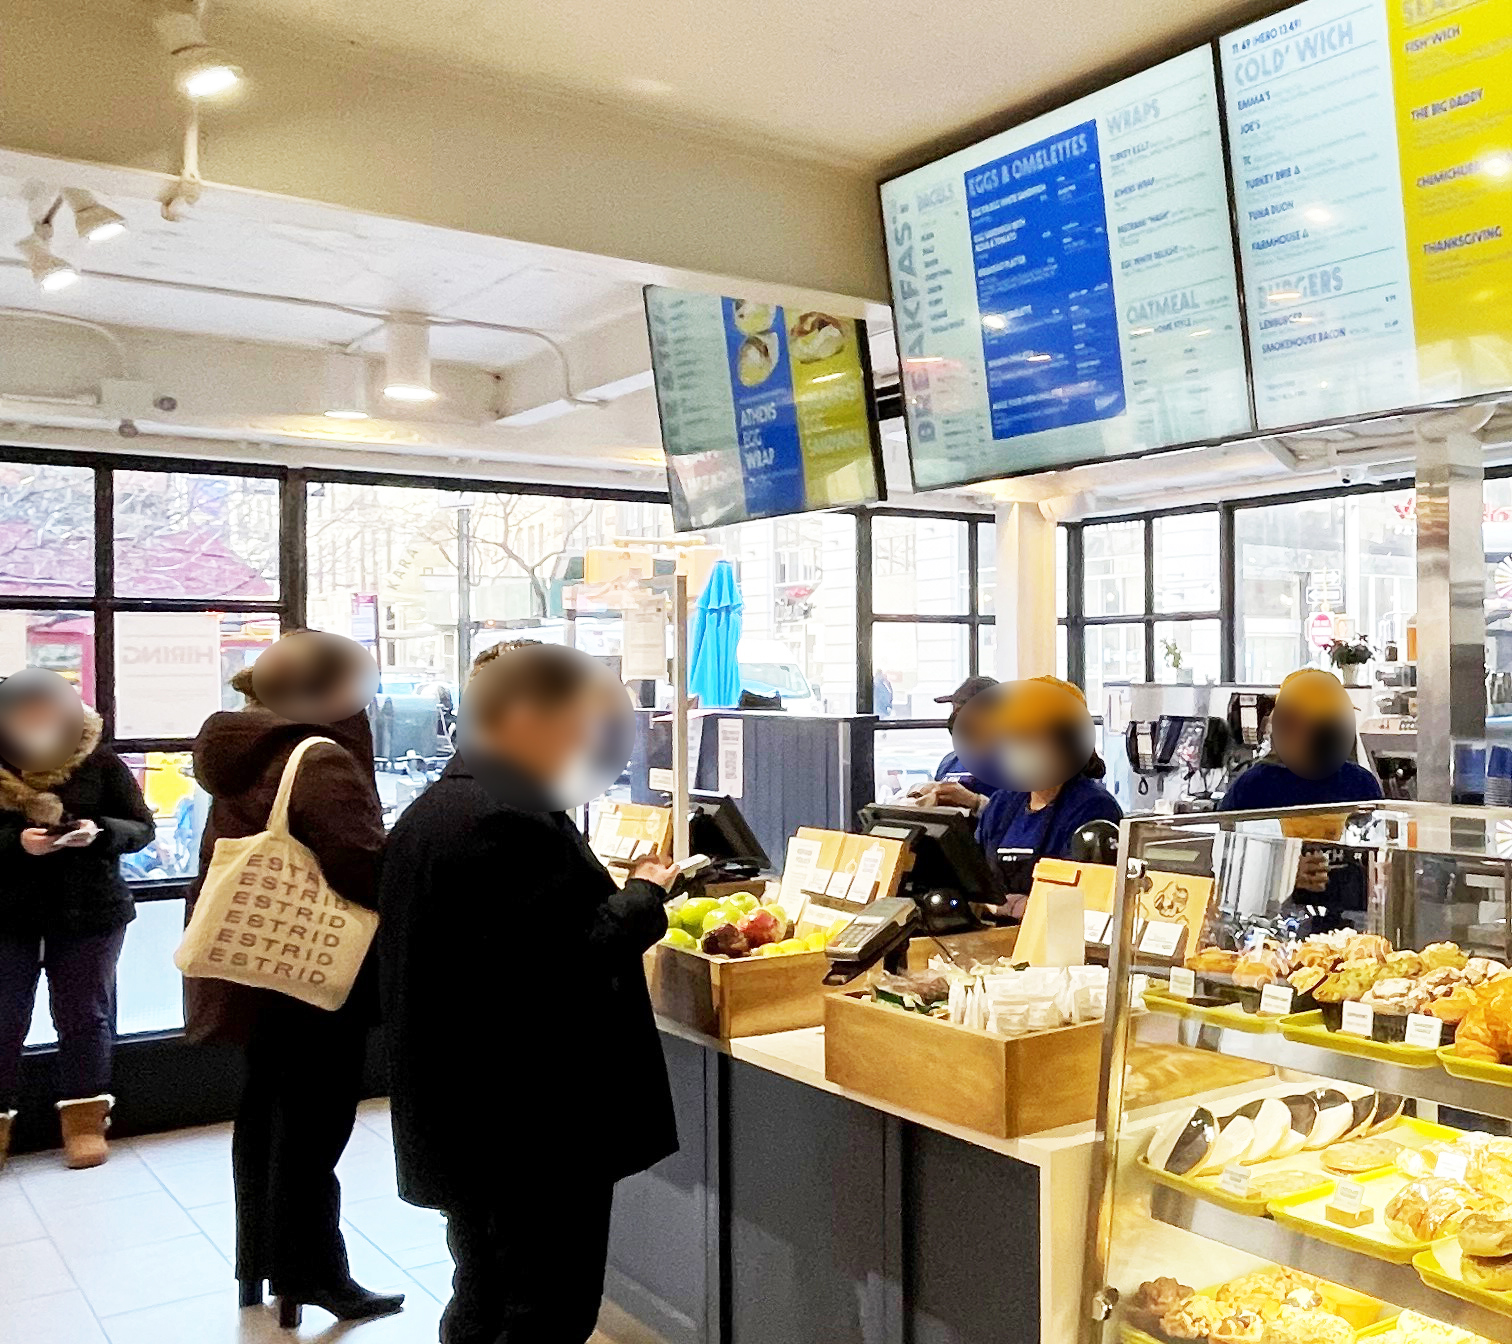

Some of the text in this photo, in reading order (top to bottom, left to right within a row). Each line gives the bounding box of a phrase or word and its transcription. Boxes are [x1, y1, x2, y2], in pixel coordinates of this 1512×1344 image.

[1296, 20, 1353, 62] WICH
[1106, 98, 1161, 136] WRAPS
[1411, 106, 1428, 120] THE
[967, 169, 999, 197] EGGS
[1011, 133, 1088, 179] OMELETTES
[1423, 225, 1503, 255] THANKSGIVING
[1126, 289, 1200, 325] OATMEAL
[231, 891, 346, 930] ESTRID
[238, 872, 350, 912] ESTRID
[217, 928, 333, 966] ESTRID
[224, 910, 340, 948] ESTRID
[208, 947, 326, 986] ESTRID
